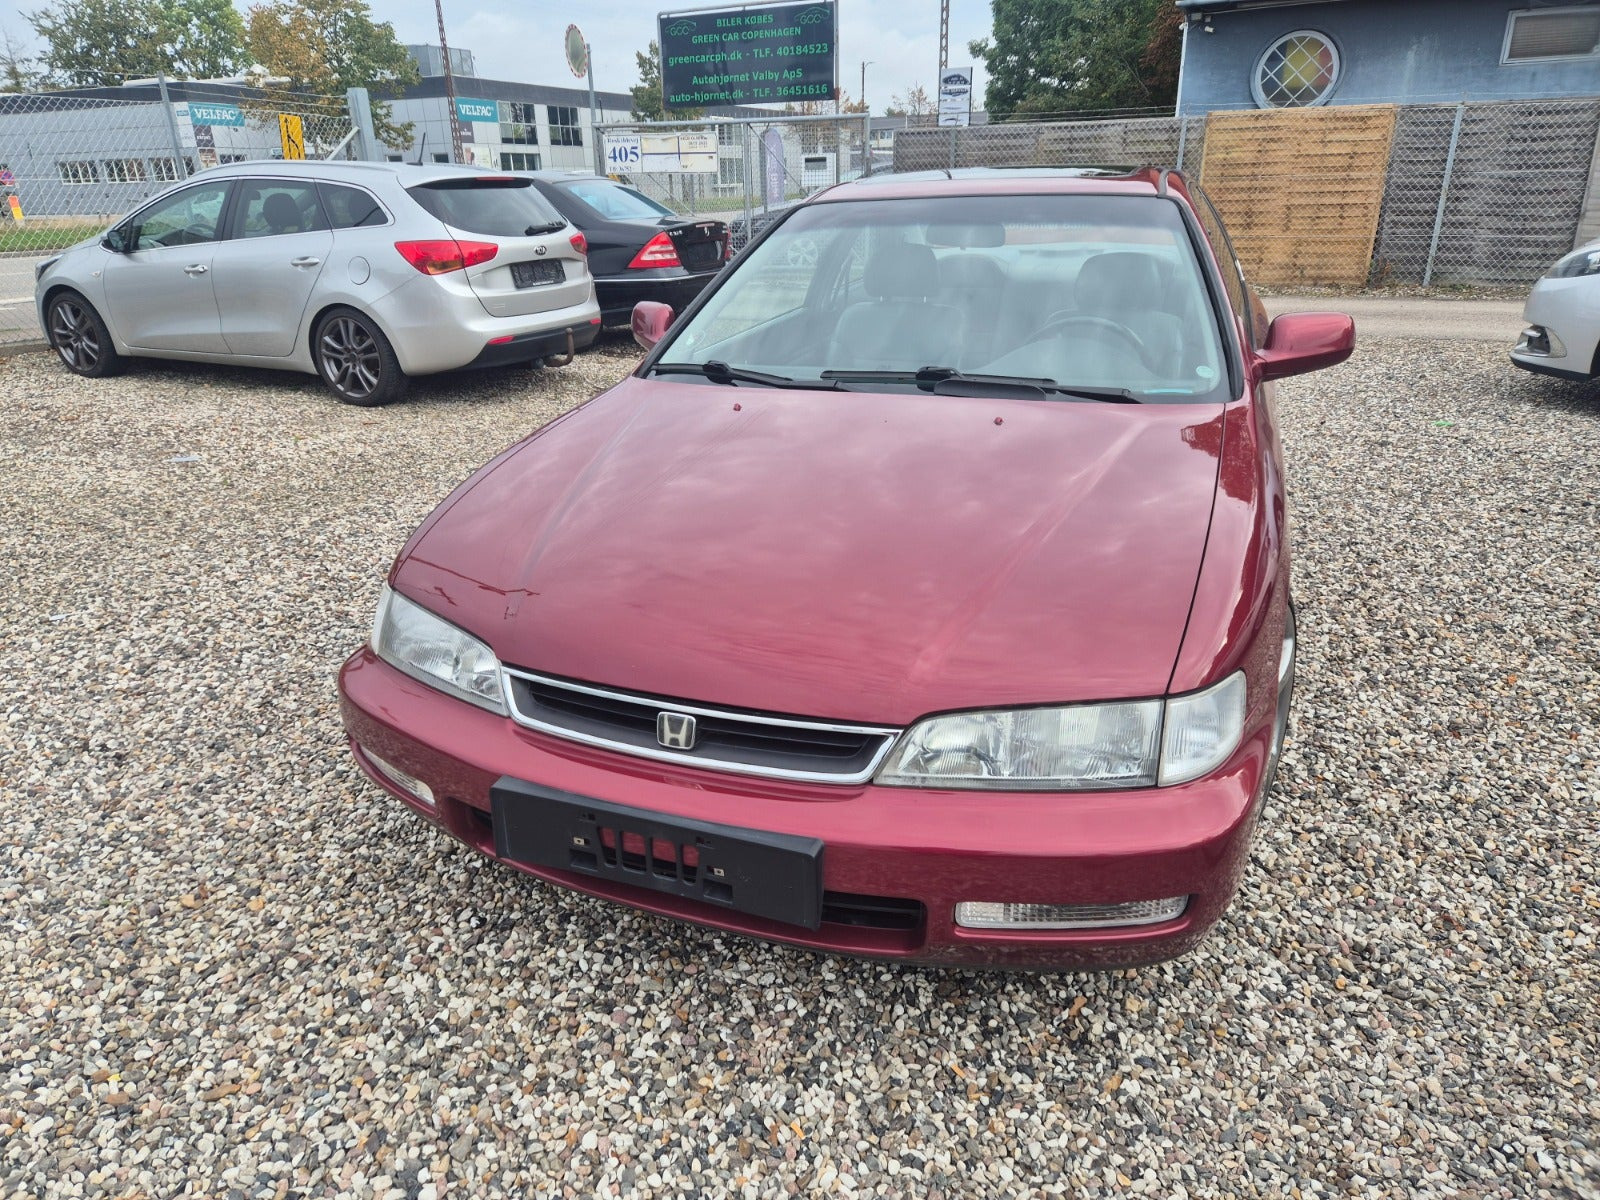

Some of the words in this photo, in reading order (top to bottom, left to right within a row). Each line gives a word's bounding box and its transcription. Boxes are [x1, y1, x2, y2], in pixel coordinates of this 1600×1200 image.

[716, 17, 742, 27] BILER
[744, 14, 774, 25] KØBES
[691, 33, 720, 44] GREEN
[722, 32, 739, 41] CAR
[741, 26, 801, 40] COPENHAGEN
[668, 51, 742, 67] greencarcph.dk
[753, 47, 774, 58] TLF.
[776, 42, 829, 57] 40184523
[752, 69, 780, 81] Valby
[782, 68, 803, 80] ApS
[753, 88, 773, 98] TLF.
[776, 83, 828, 97] 36451616
[607, 146, 639, 162] 405
